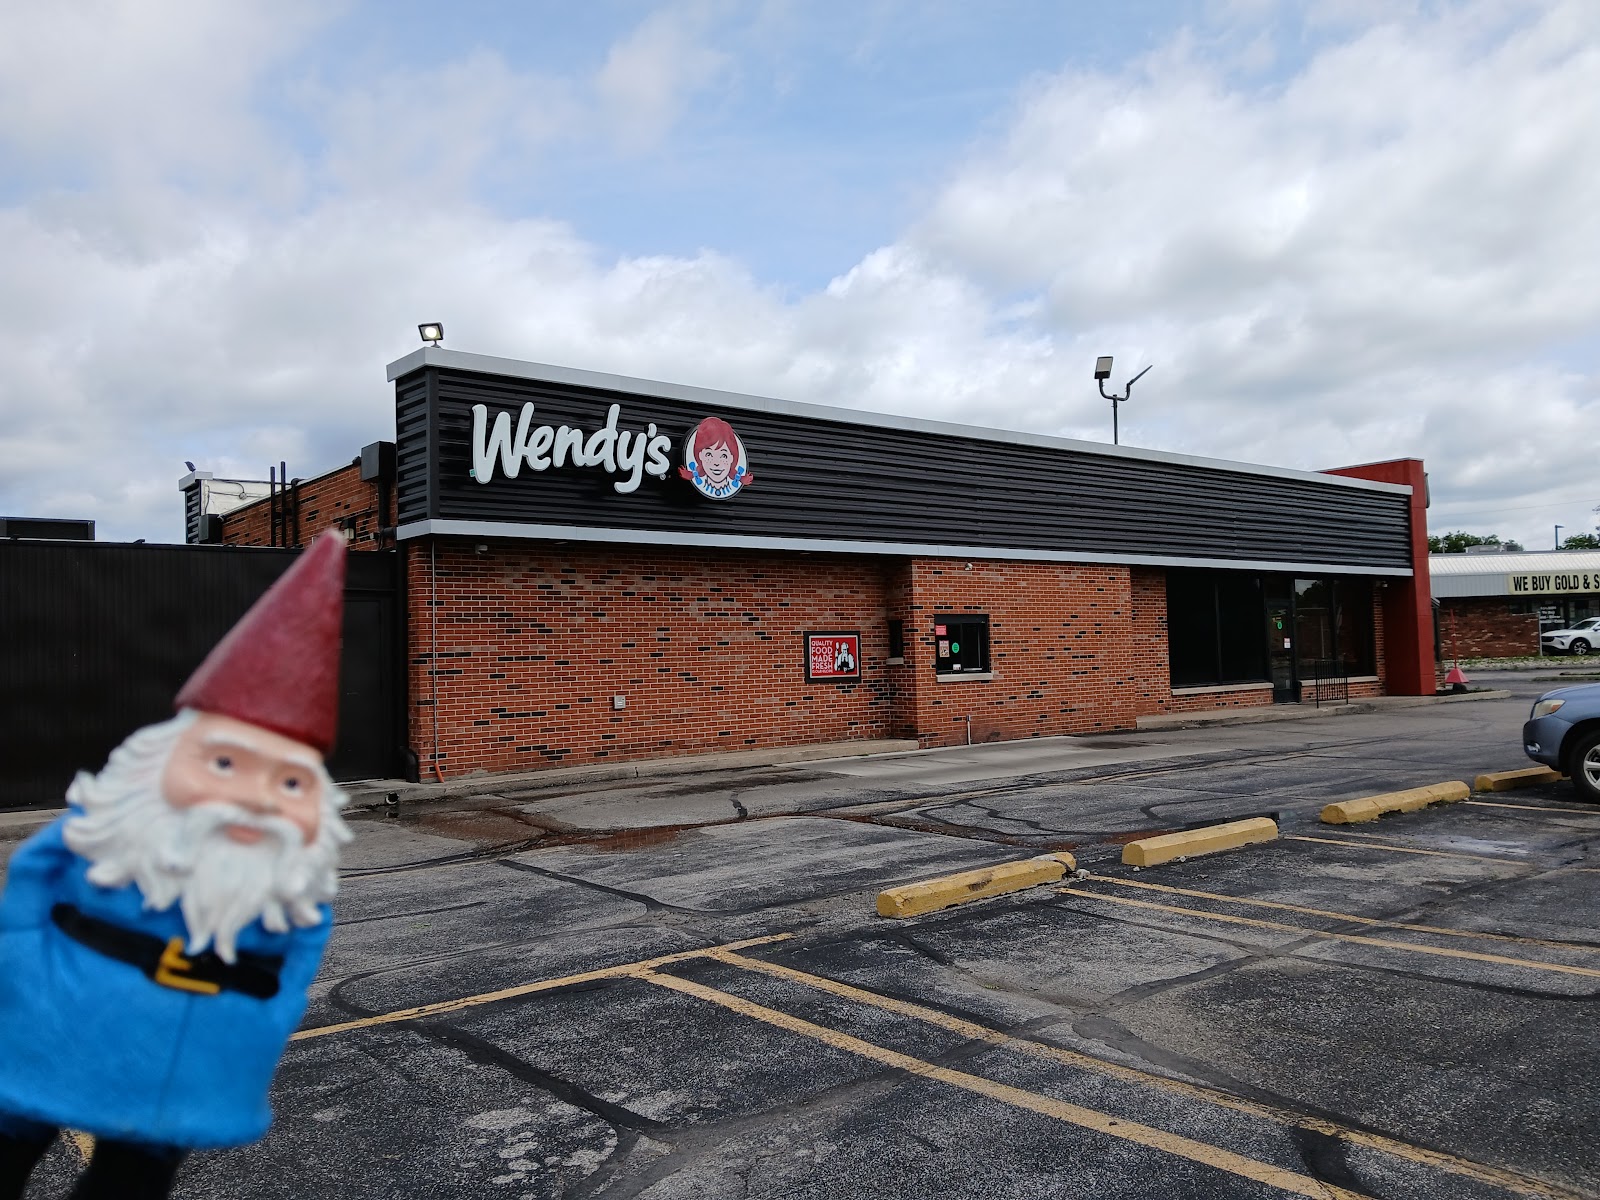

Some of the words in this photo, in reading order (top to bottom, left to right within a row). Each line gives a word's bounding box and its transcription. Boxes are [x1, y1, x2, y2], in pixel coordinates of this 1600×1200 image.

[472, 402, 671, 493] Wendy's
[1513, 576, 1529, 591] WE
[1532, 575, 1551, 591] BUY
[1554, 574, 1579, 590] GOLD
[1583, 574, 1591, 590] &
[811, 662, 833, 670] FRESH
